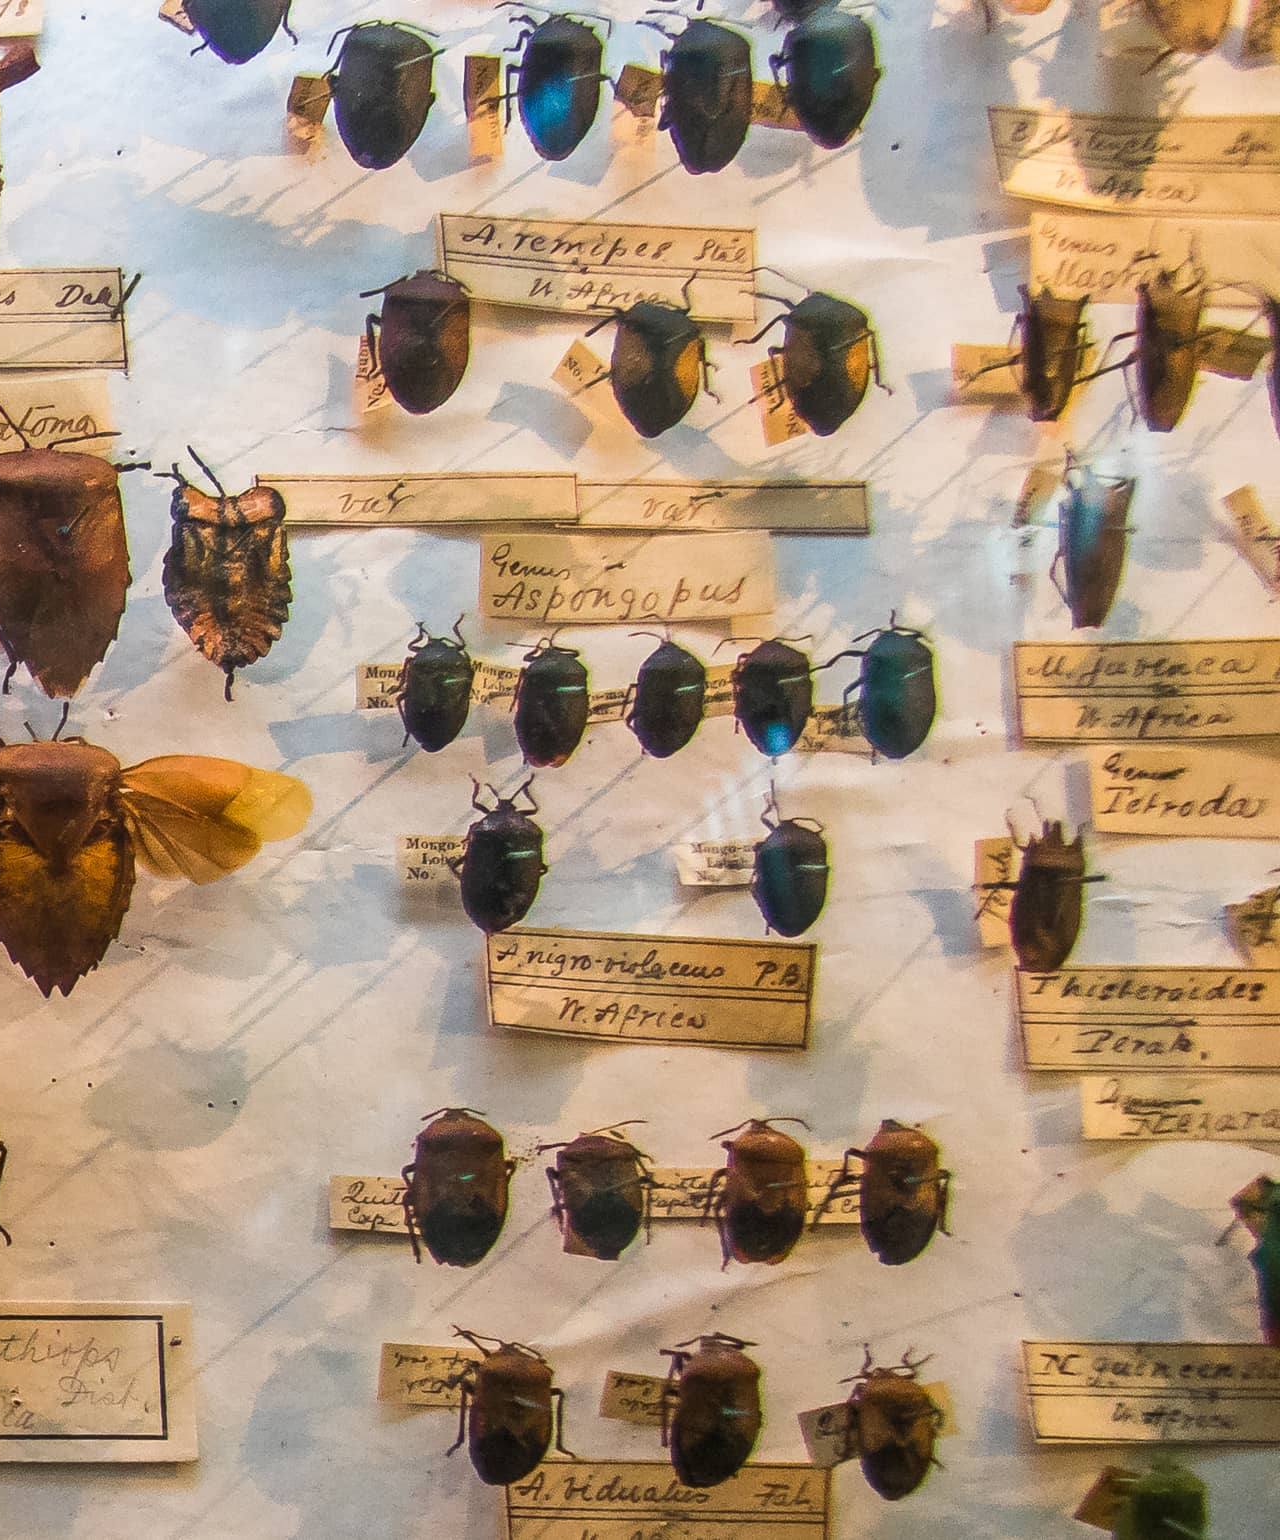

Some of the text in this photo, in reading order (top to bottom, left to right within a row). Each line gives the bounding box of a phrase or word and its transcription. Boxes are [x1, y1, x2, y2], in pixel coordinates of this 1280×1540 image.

[491, 543, 569, 579] Genus
[492, 576, 748, 620] Aspongopus
[594, 1000, 706, 1037] Africa
